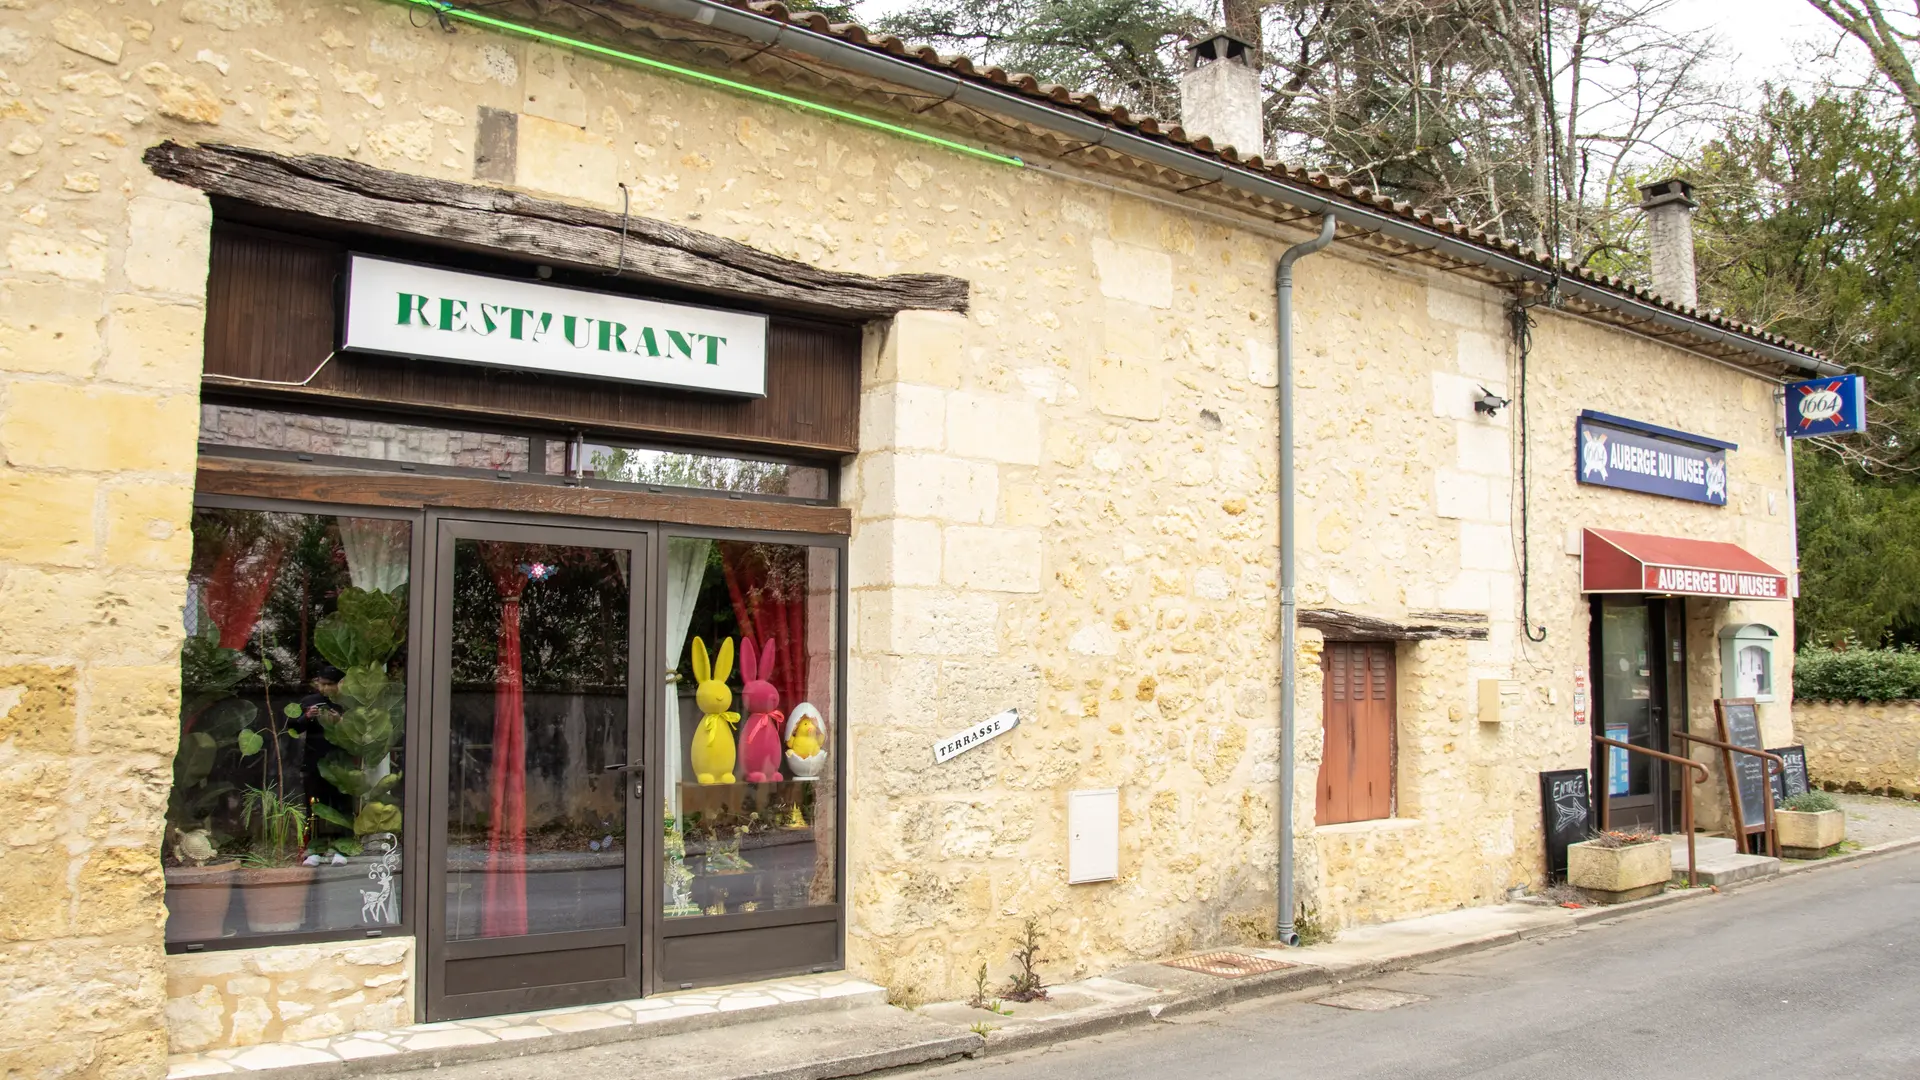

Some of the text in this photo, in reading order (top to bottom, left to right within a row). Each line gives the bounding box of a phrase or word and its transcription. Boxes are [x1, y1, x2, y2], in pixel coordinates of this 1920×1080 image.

[1802, 395, 1838, 413] 1664
[1609, 443, 1705, 485] AUBERGE DU MUSEE
[1658, 568, 1777, 597] AUBERGE DU MUSEE
[939, 720, 1002, 757] TERRASSE
[1553, 775, 1586, 799] ENTRÉE
